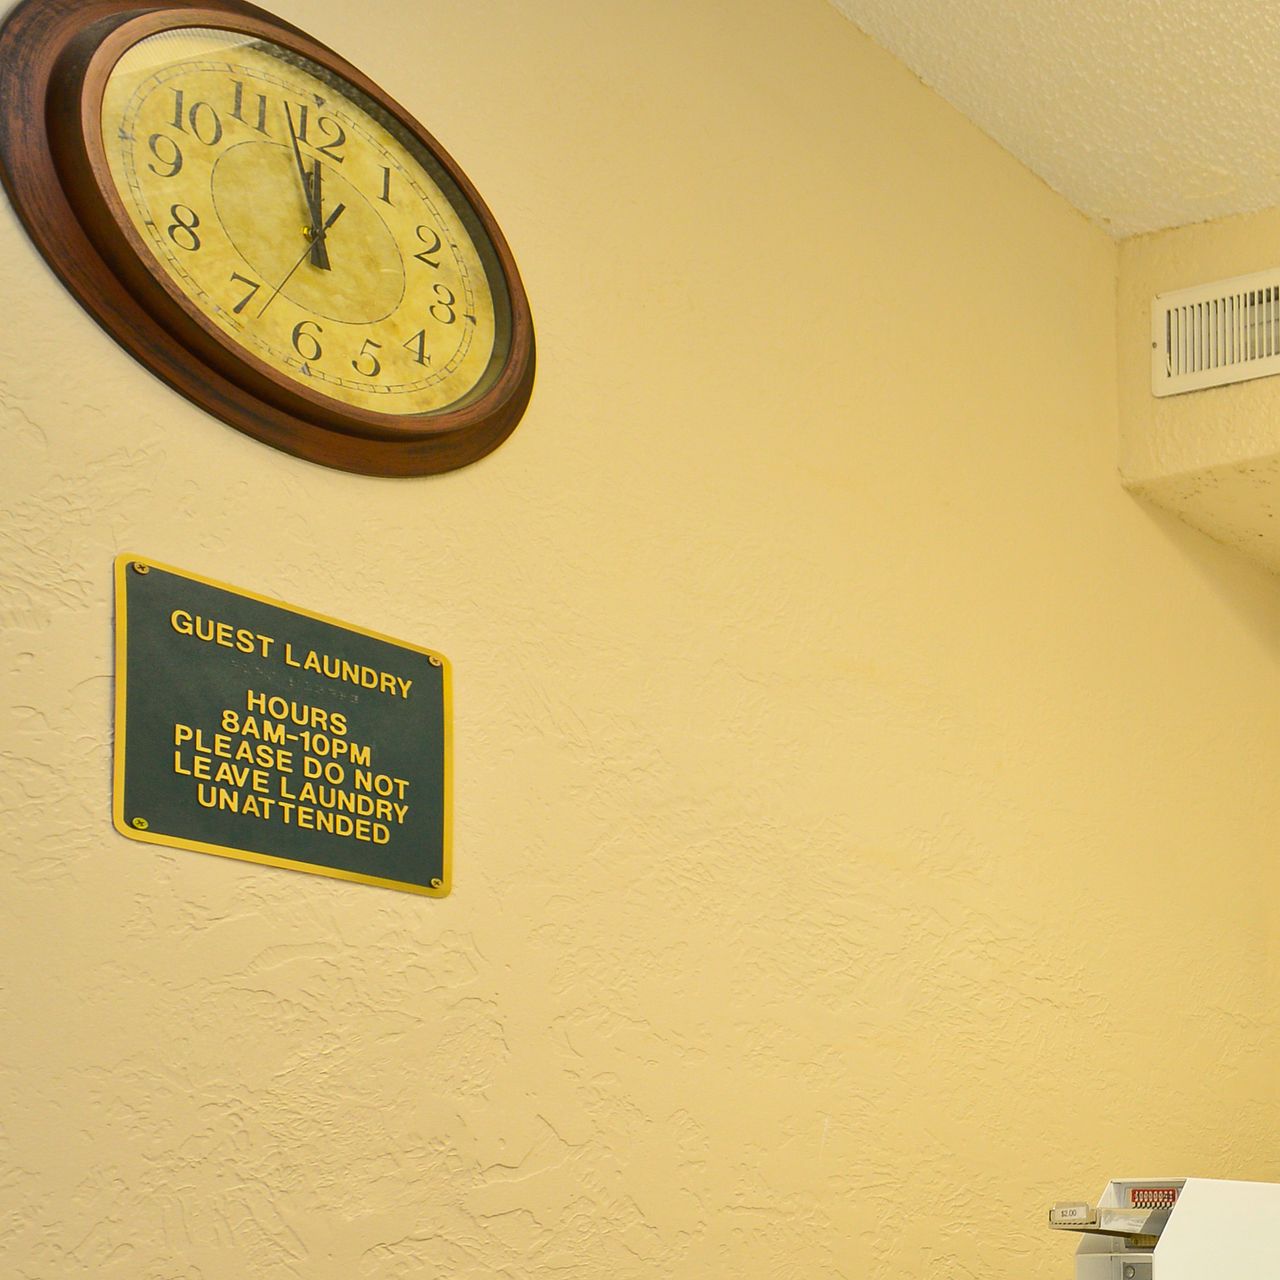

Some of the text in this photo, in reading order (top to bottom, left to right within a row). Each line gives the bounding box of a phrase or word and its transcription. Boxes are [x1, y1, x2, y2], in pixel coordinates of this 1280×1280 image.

[167, 87, 223, 146] 10
[227, 78, 272, 138] 11
[147, 133, 183, 178] 9
[295, 103, 346, 163] 12
[377, 165, 395, 207] 1
[167, 204, 200, 251] 8
[414, 225, 442, 269] 2
[230, 272, 260, 314] 7
[429, 284, 455, 325] 3
[291, 320, 323, 361] 6
[351, 338, 382, 377] 5
[402, 329, 431, 367] 4
[170, 609, 413, 699] GUEST LAUNDRY
[247, 689, 348, 736] HOURS
[174, 723, 410, 800] PLEASE DO NOT
[221, 709, 371, 767] 8AM-10PM
[174, 751, 409, 824] LEAVE LAUNDRY
[197, 783, 391, 845] UNATTENDED
[1060, 1209, 1077, 1218] $2.00
